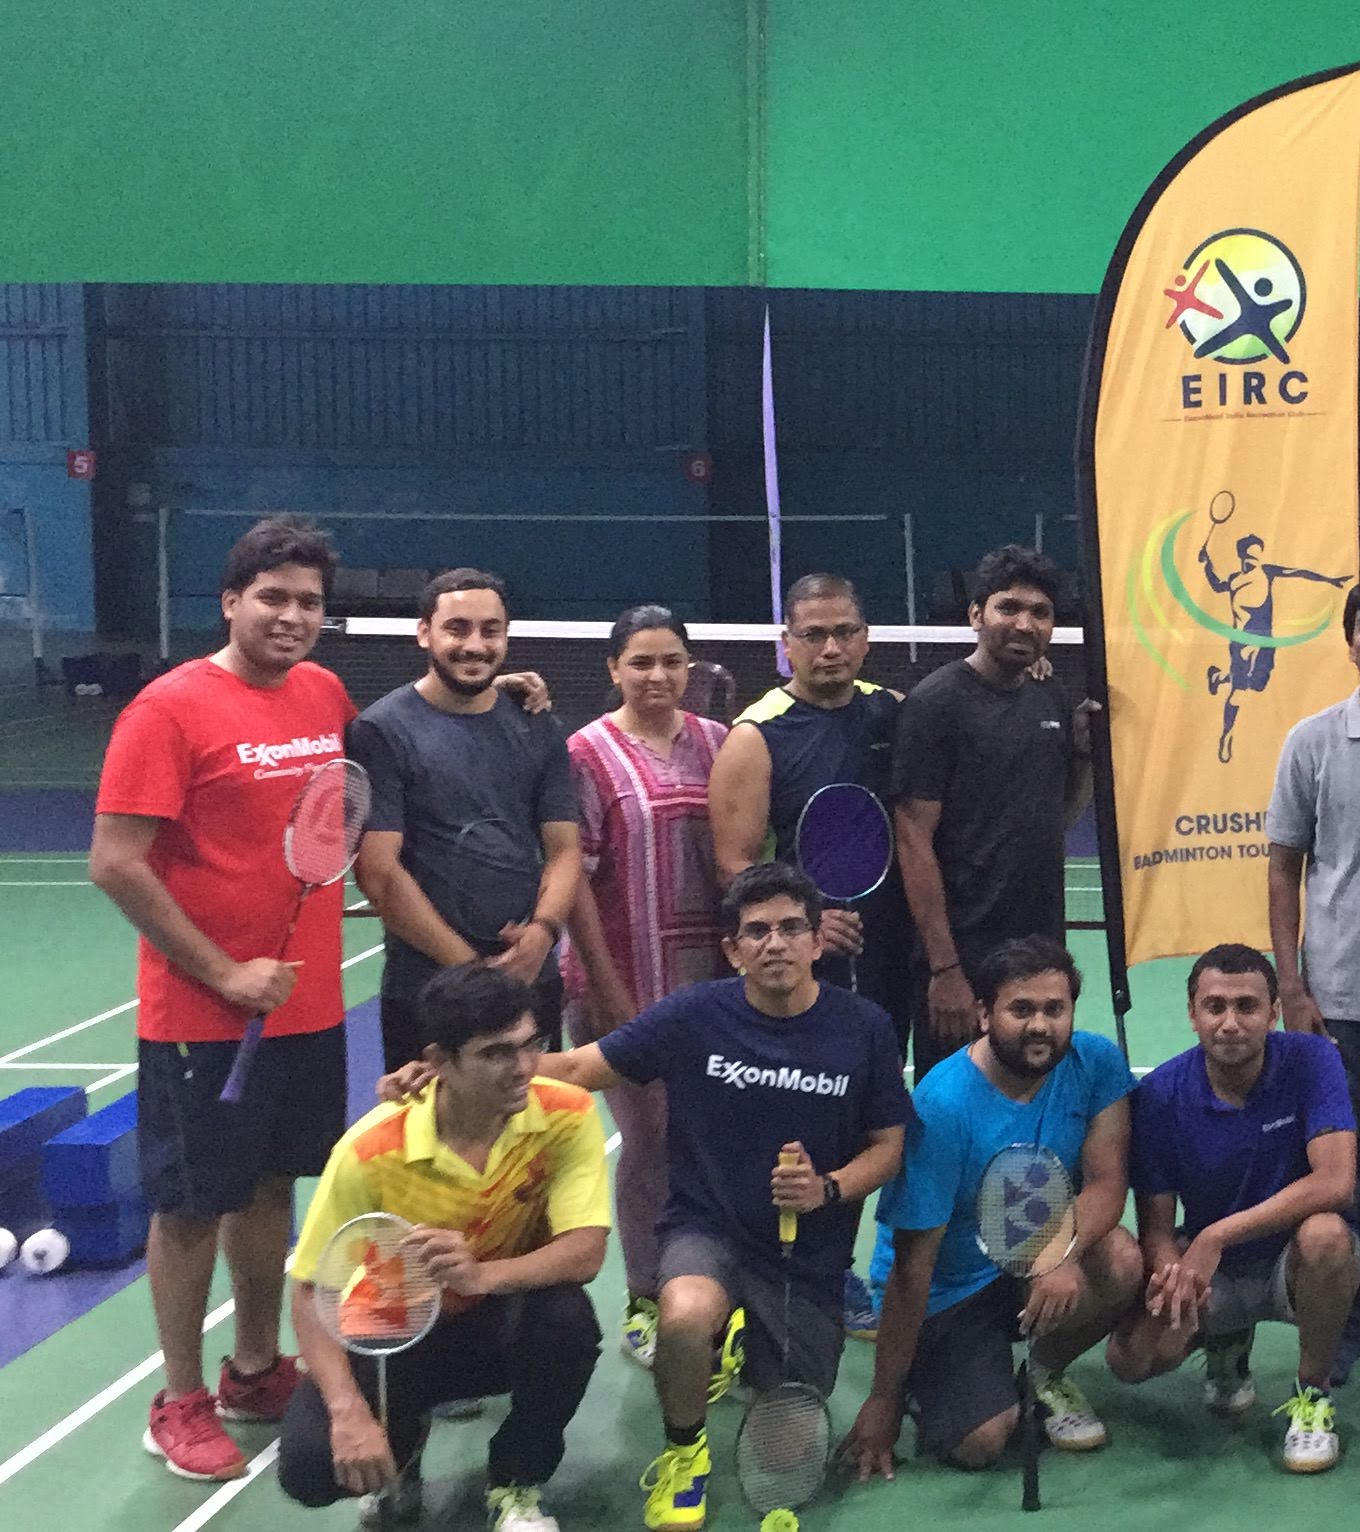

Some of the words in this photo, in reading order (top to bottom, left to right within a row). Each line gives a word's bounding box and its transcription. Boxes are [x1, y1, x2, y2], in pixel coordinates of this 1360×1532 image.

[1182, 370, 1309, 409] EIRC
[73, 455, 89, 474] 5
[691, 459, 706, 477] 6
[235, 732, 343, 767] ExxonMobil
[1175, 811, 1268, 836] CRUSH
[1133, 844, 1233, 870] BADMINTON
[706, 1053, 850, 1097] ExxonMobil
